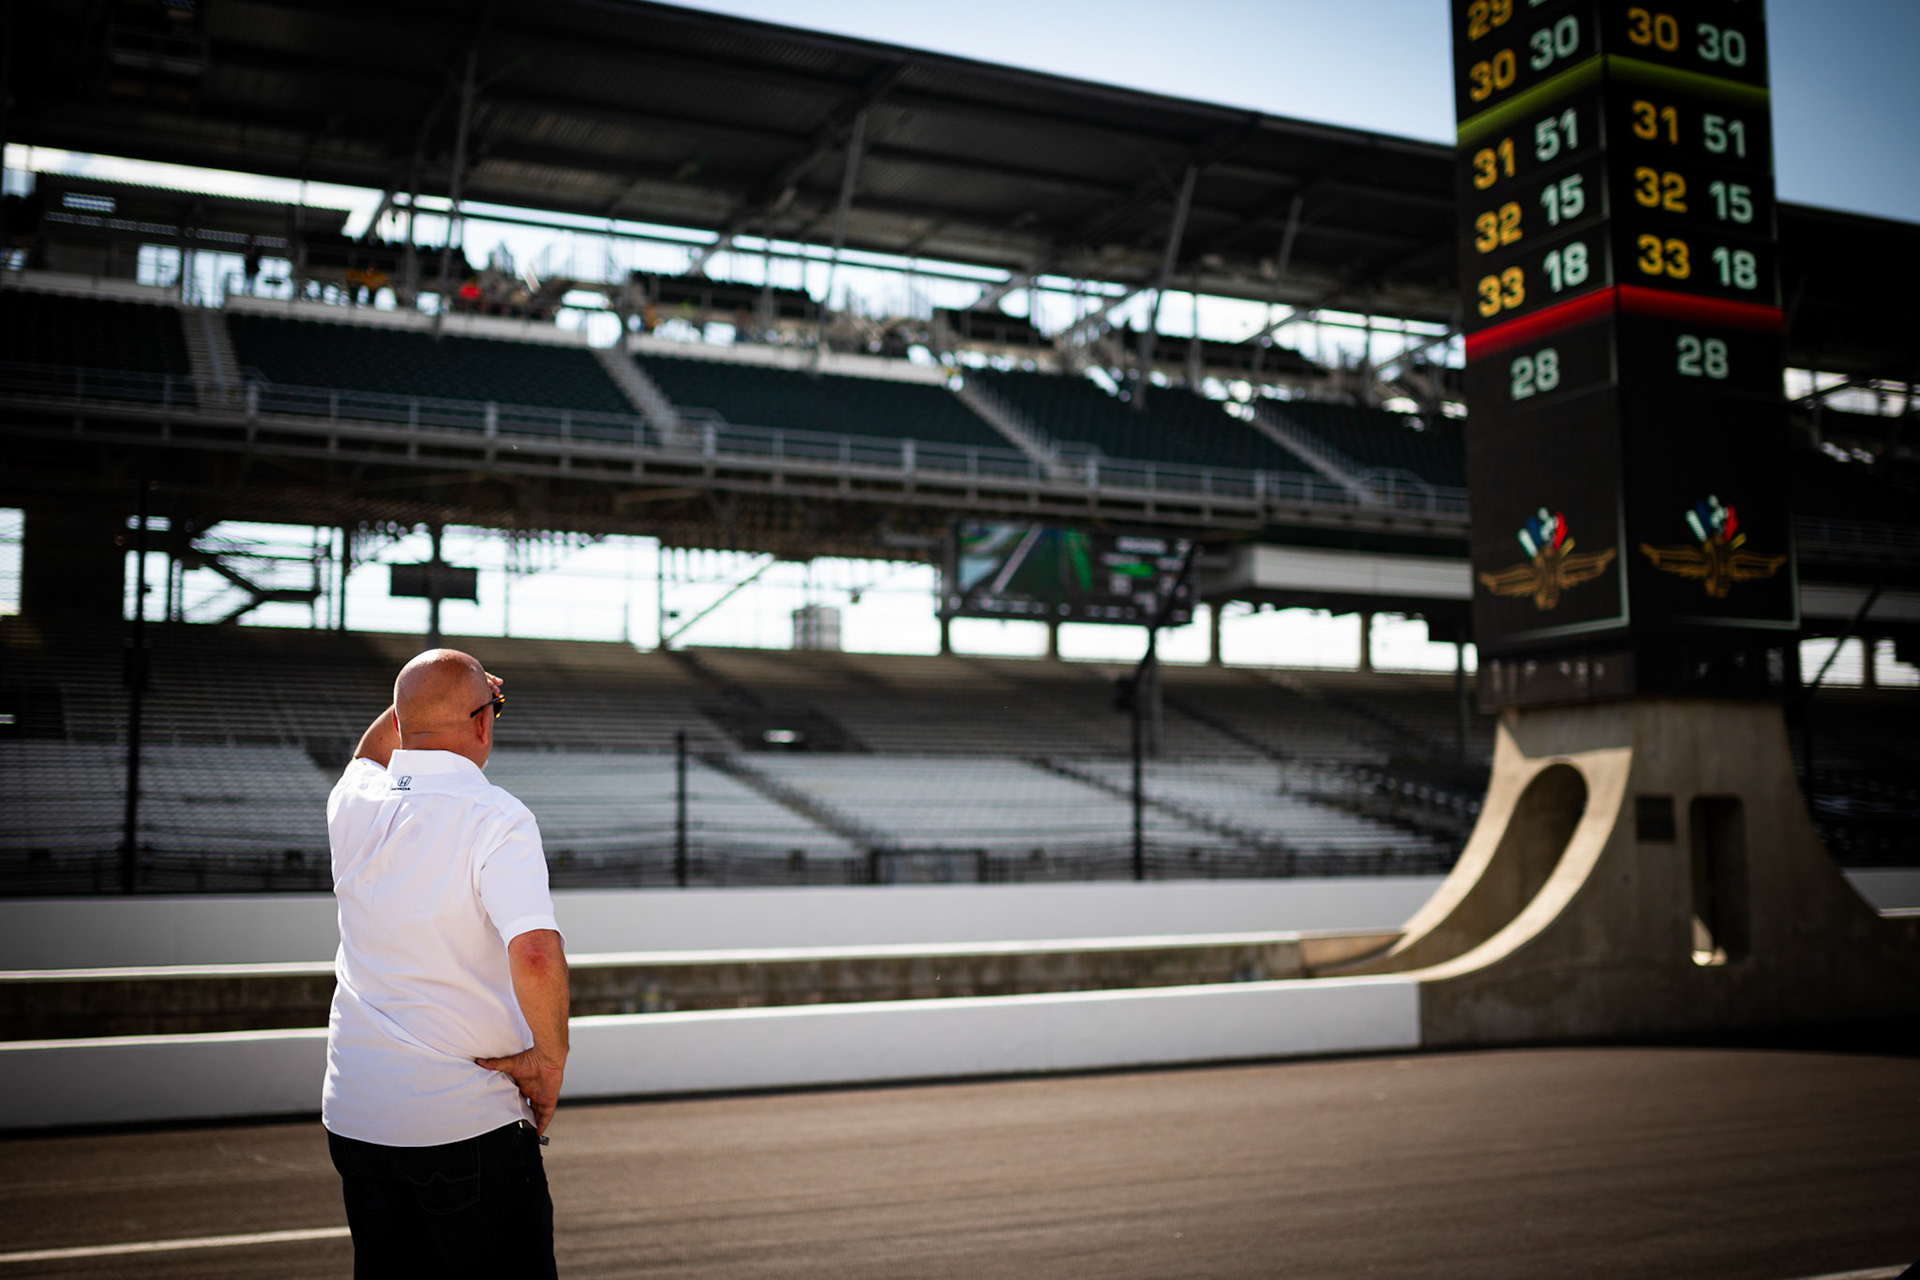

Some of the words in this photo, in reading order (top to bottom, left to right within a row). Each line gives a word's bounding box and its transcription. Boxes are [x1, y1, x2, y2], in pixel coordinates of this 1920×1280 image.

[1467, 0, 1513, 41] 29
[1628, 7, 1679, 51] 30
[1697, 23, 1746, 67] 30
[1470, 49, 1516, 101] 30
[1530, 15, 1579, 70] 30
[1473, 138, 1515, 189] 31
[1535, 108, 1577, 162] 51
[1632, 100, 1679, 144] 31
[1703, 113, 1745, 157] 51
[1476, 202, 1523, 253] 32
[1540, 174, 1585, 226] 15
[1635, 167, 1687, 212] 32
[1709, 180, 1753, 224] 15
[1478, 266, 1525, 317] 33
[1543, 241, 1589, 293] 18
[1638, 234, 1690, 279] 33
[1712, 246, 1758, 290] 18
[1510, 348, 1560, 400] 28
[1676, 334, 1729, 379] 28
